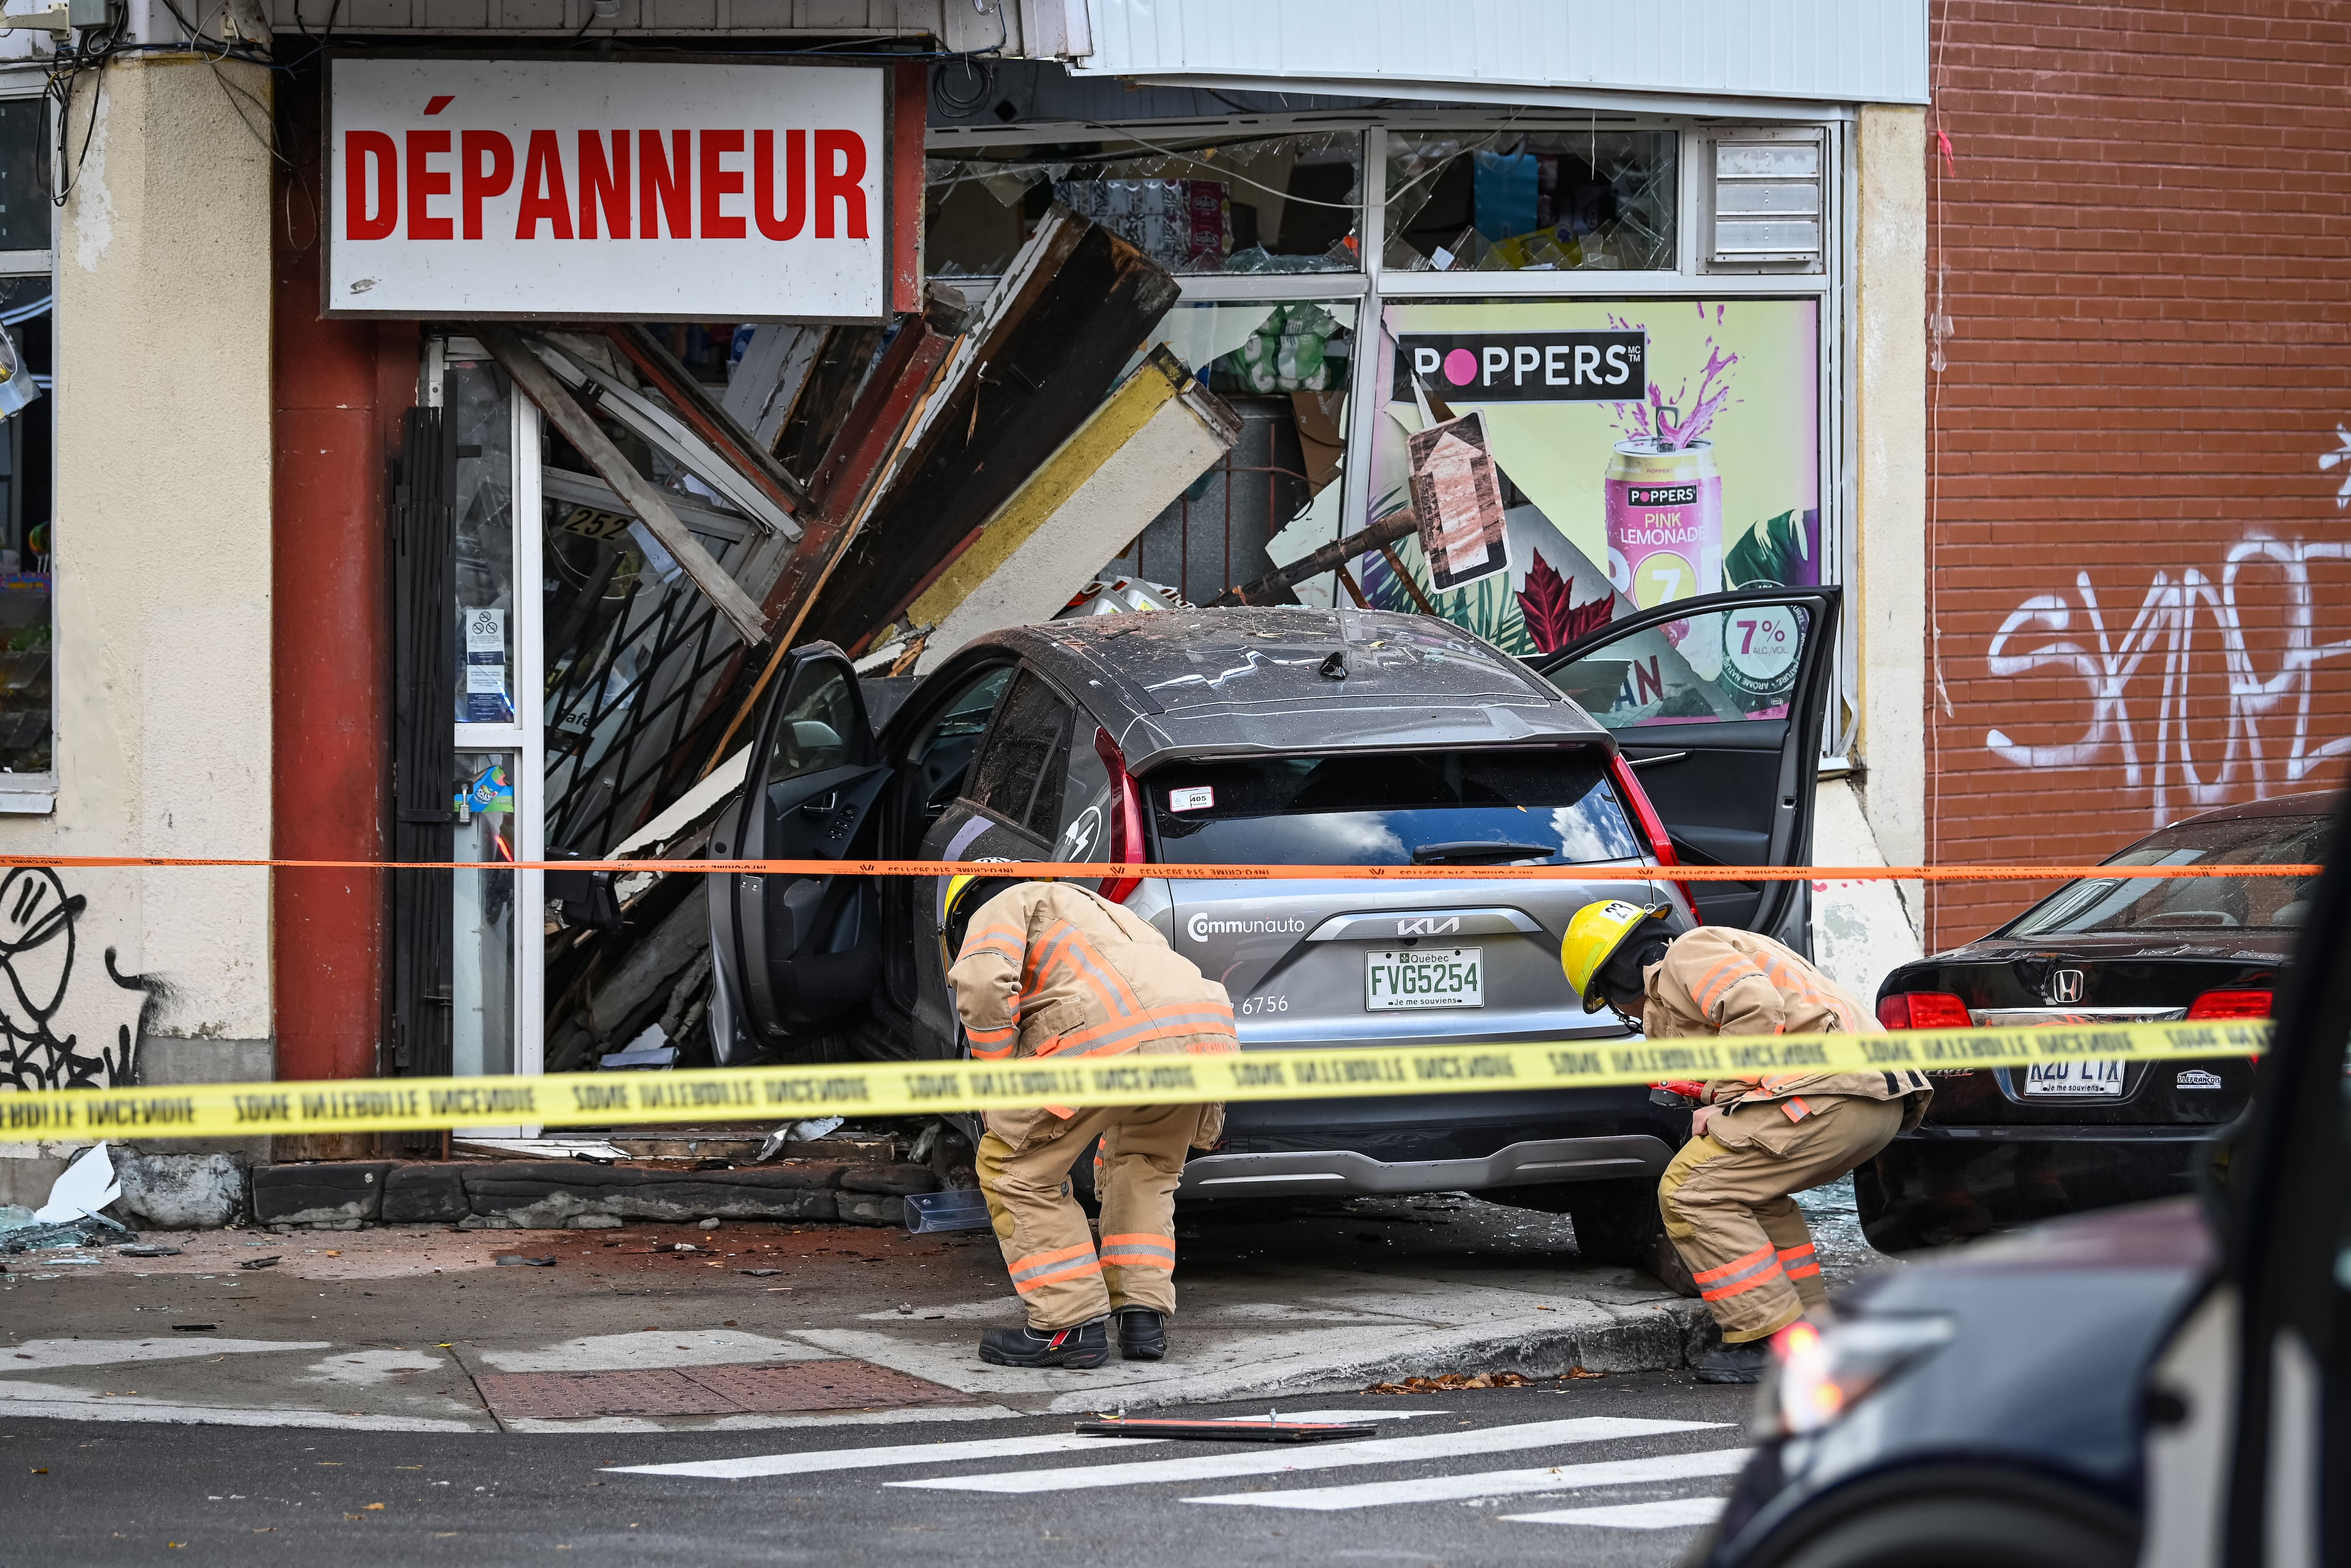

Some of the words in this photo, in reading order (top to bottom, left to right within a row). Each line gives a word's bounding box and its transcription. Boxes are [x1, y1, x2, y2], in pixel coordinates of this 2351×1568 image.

[346, 95, 870, 240] DÉPANNEUR
[1628, 354, 1641, 362] TM
[1631, 488, 1694, 503] POPPERS
[564, 509, 629, 541] 252
[1644, 512, 1682, 528] PINK
[1620, 526, 1708, 545] LEMONADE
[1603, 901, 1631, 921] 23
[1187, 911, 1305, 944] Communauto
[1396, 916, 1460, 936] KIA
[1411, 953, 1449, 965] Québec
[1371, 962, 1478, 996] FVG5254
[1242, 995, 1289, 1015] 6756
[1394, 998, 1403, 1006] Je
[2178, 1076, 2220, 1085] S.LEFRANÇOIS
